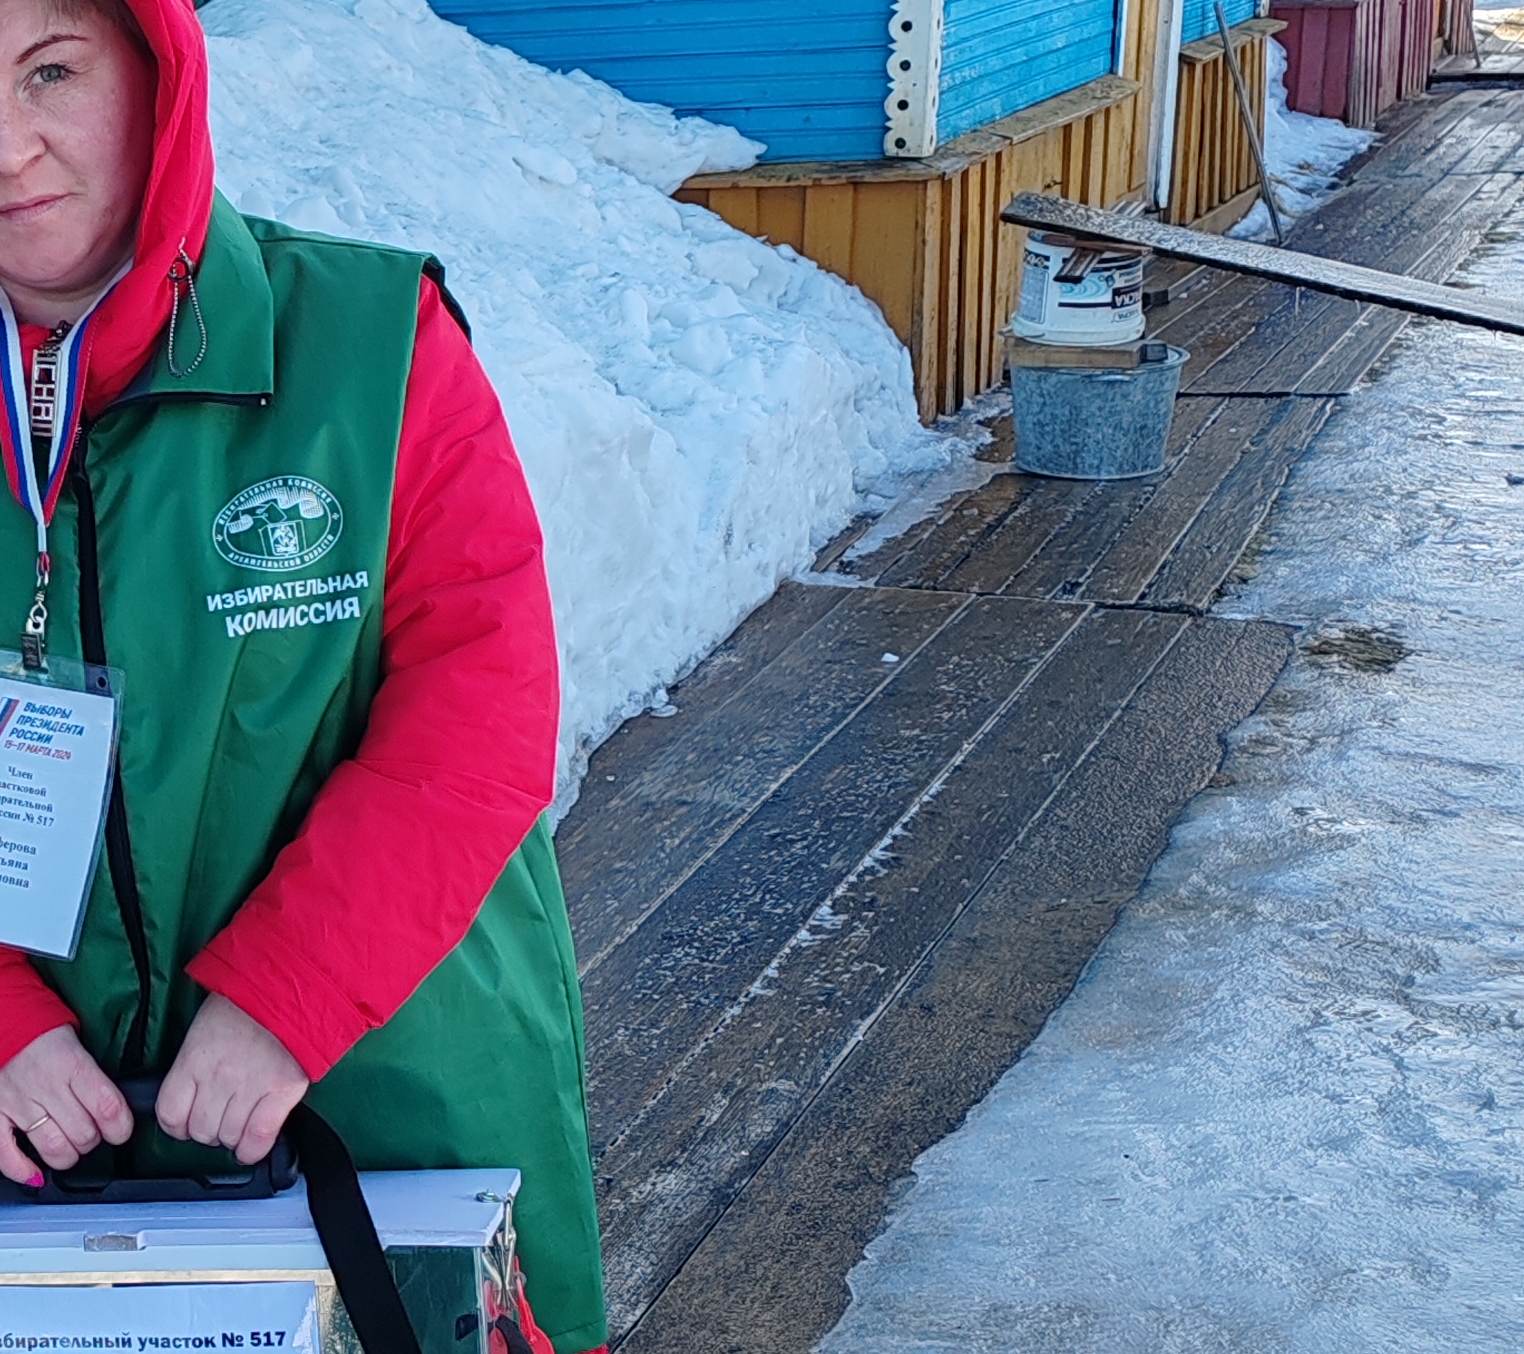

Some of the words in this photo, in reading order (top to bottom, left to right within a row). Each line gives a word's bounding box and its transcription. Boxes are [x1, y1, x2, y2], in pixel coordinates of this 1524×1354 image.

[206, 571, 369, 612] ИЗБИРАТЕЛЬНАЯ
[225, 596, 361, 638] КОМИССИЯ
[23, 702, 74, 720] ВЫБОРЫ
[16, 714, 84, 737] ПРЕЗИДЕНТА
[8, 727, 54, 744] РОССИИ
[25, 744, 51, 757] МАРТА
[7, 765, 33, 780] Член
[22, 812, 34, 823] №
[36, 815, 54, 827] 517
[138, 1335, 216, 1352] участок
[222, 1332, 244, 1347] №
[250, 1331, 286, 1347] 517
